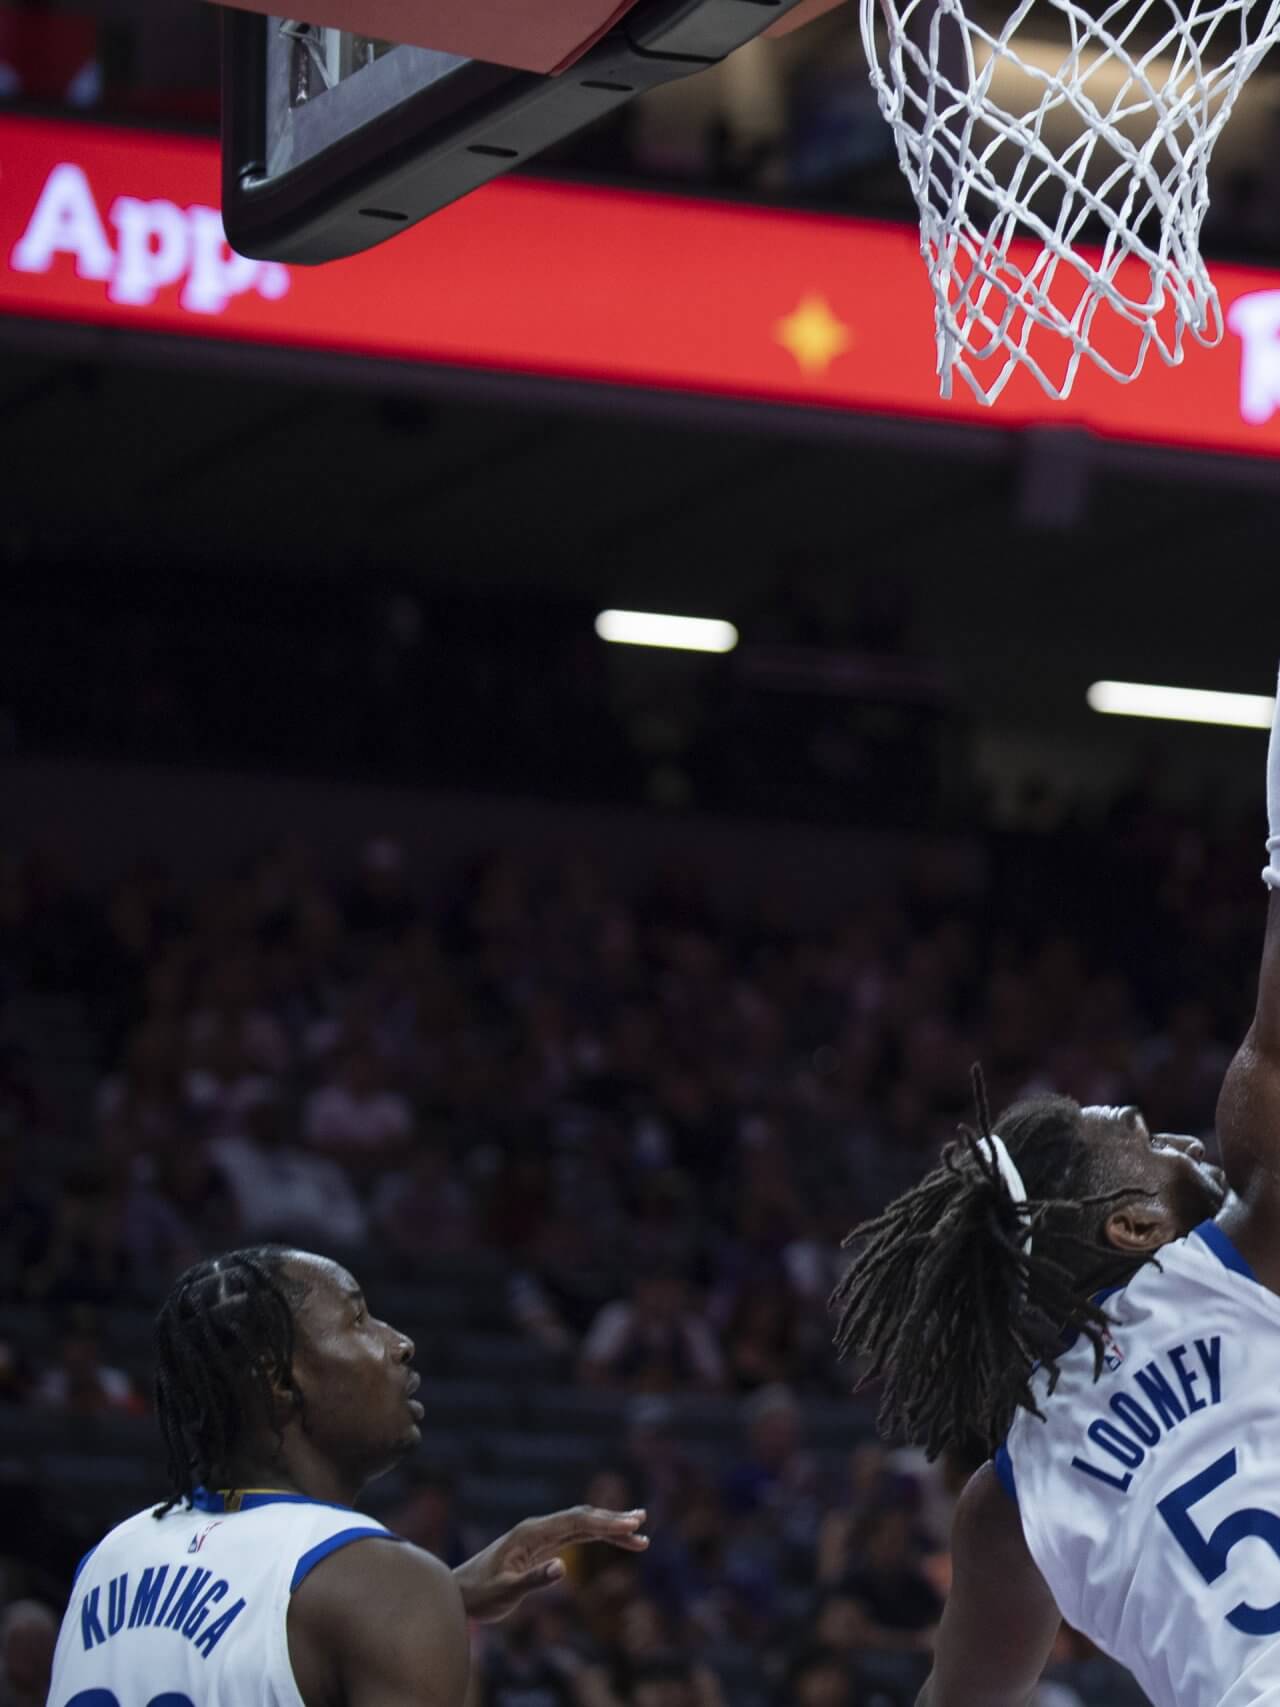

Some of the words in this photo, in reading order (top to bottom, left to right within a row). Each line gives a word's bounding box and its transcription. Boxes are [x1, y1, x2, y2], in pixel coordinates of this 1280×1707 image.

[11, 162, 291, 313] App.
[1071, 1336, 1221, 1493] LOONEY
[81, 1563, 247, 1659] KUMINGA
